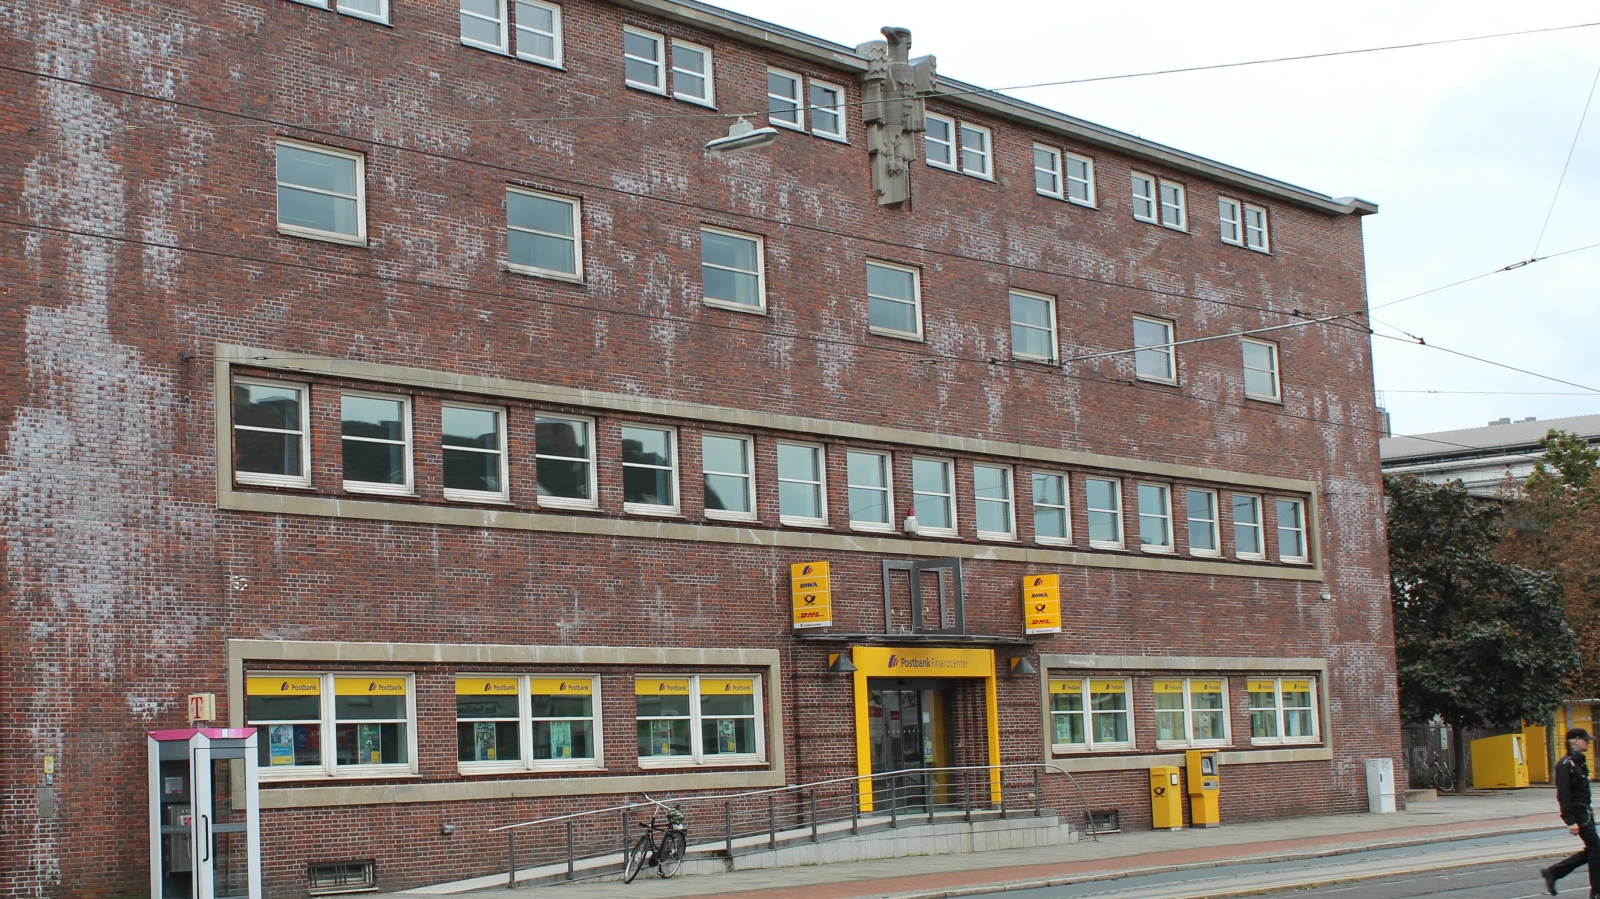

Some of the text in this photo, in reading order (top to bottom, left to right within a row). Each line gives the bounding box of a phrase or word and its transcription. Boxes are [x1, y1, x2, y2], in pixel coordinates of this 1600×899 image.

[901, 657, 969, 668] Postbank Finanzcenter
[291, 683, 317, 691] Postbank
[191, 696, 204, 720] T
